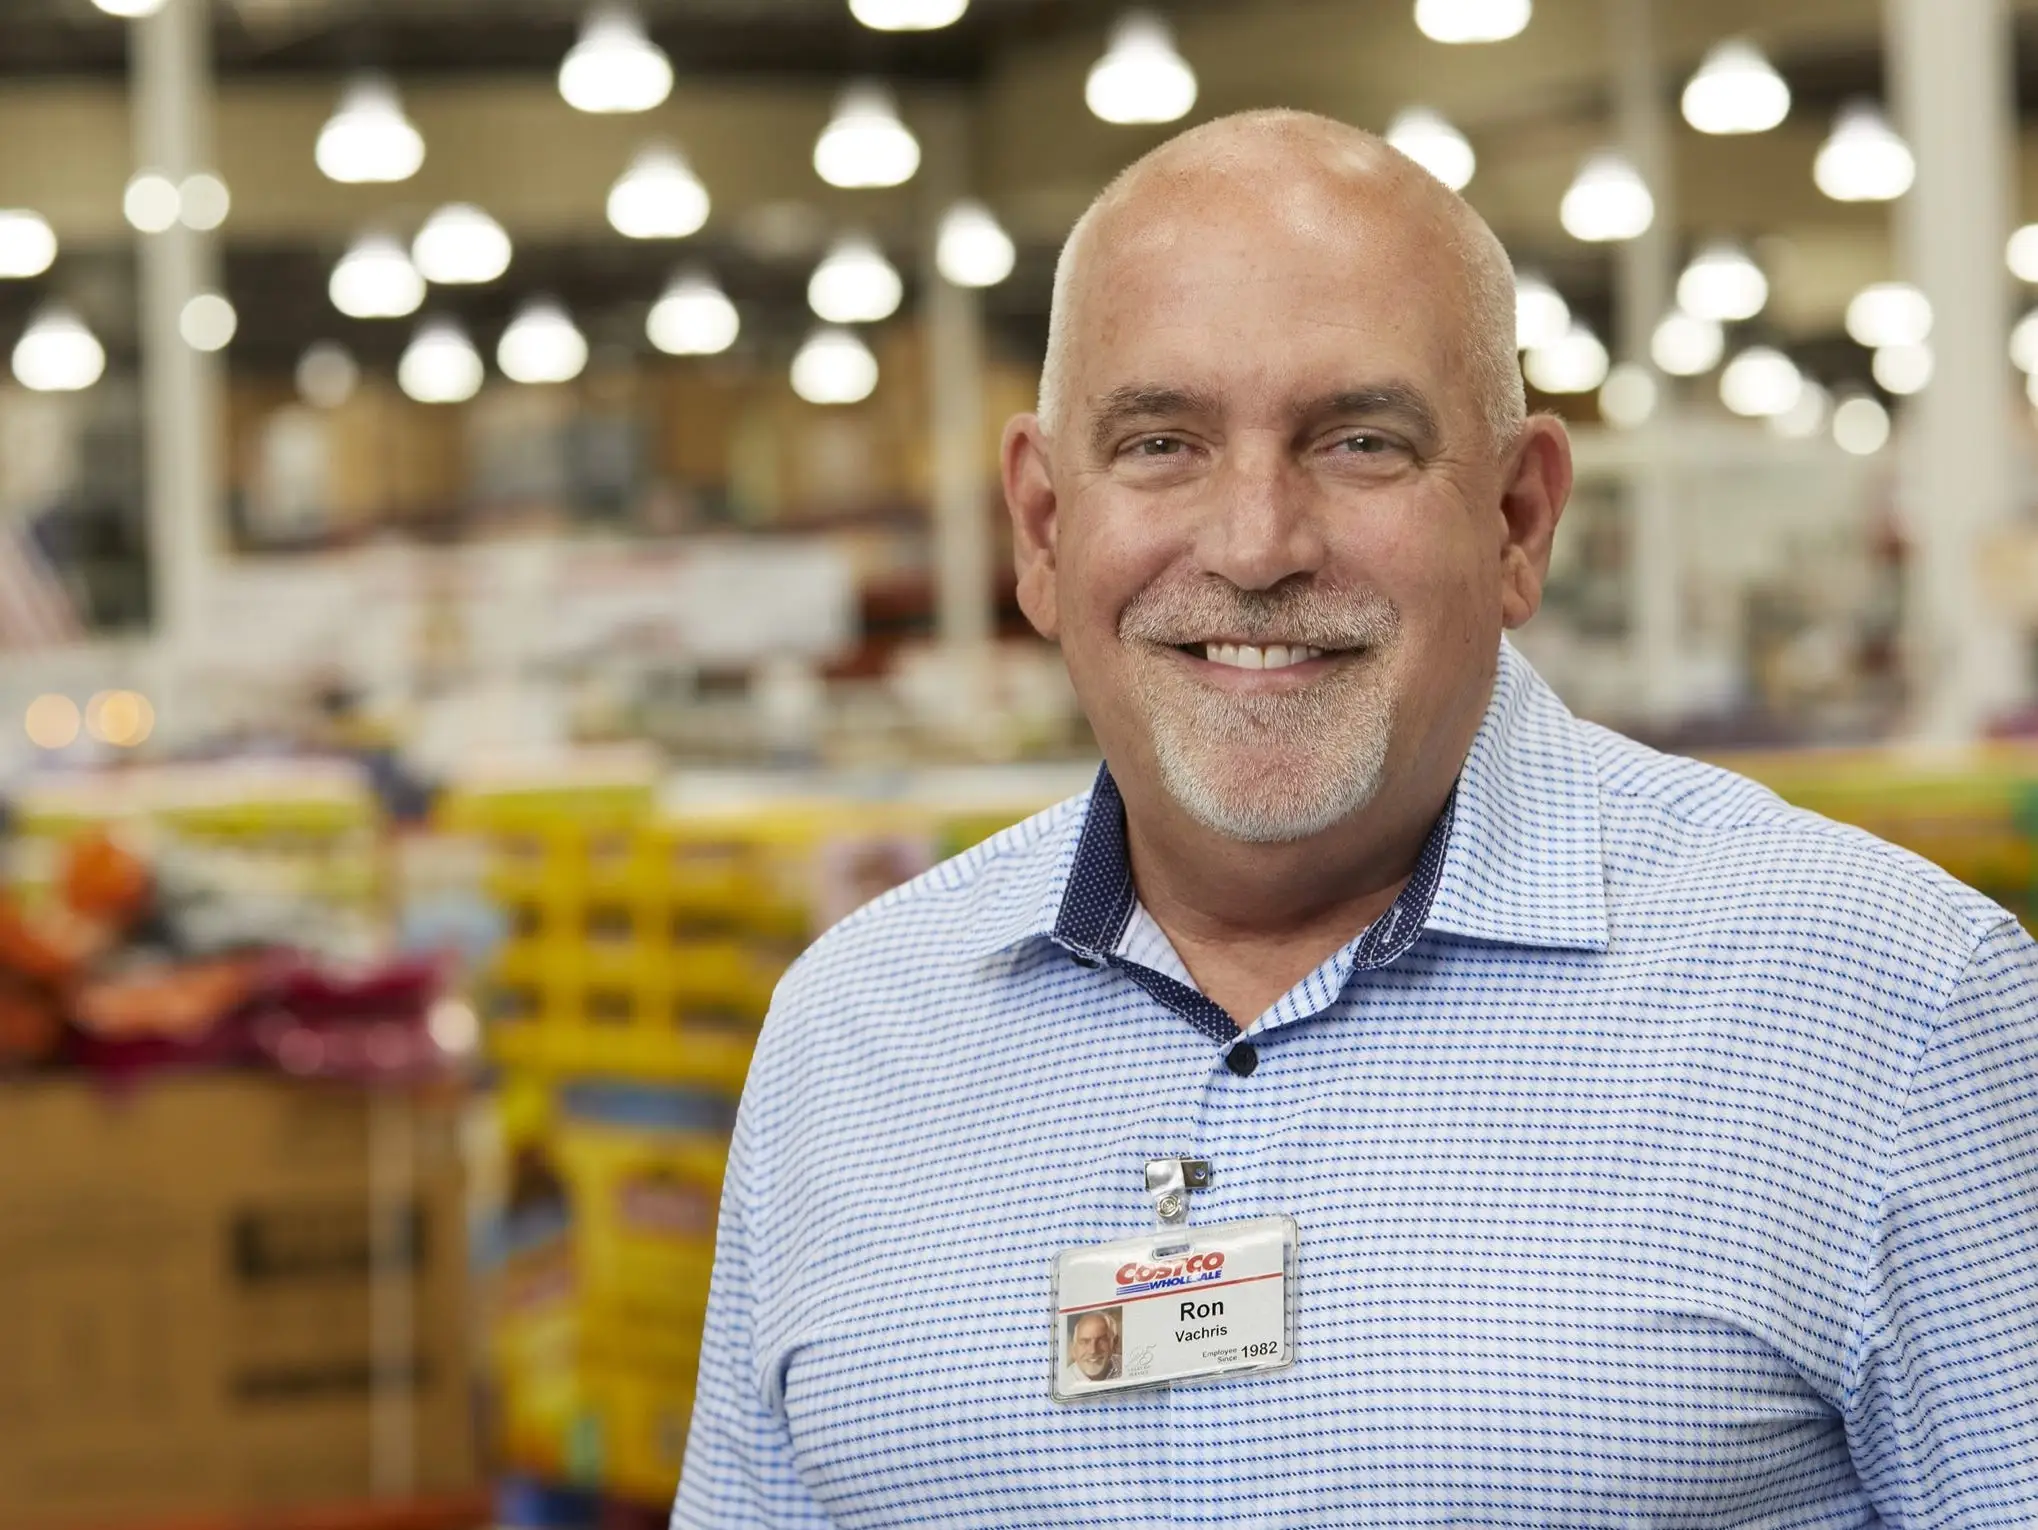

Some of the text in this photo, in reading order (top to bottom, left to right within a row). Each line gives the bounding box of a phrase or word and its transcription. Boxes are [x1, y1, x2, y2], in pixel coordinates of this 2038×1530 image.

[1116, 1252, 1225, 1285] COSTCO
[1180, 1300, 1224, 1322] Ron
[1175, 1324, 1228, 1343] Vachris
[1202, 1347, 1238, 1359] Employee
[1241, 1340, 1278, 1358] 1982
[1217, 1354, 1238, 1363] Since
